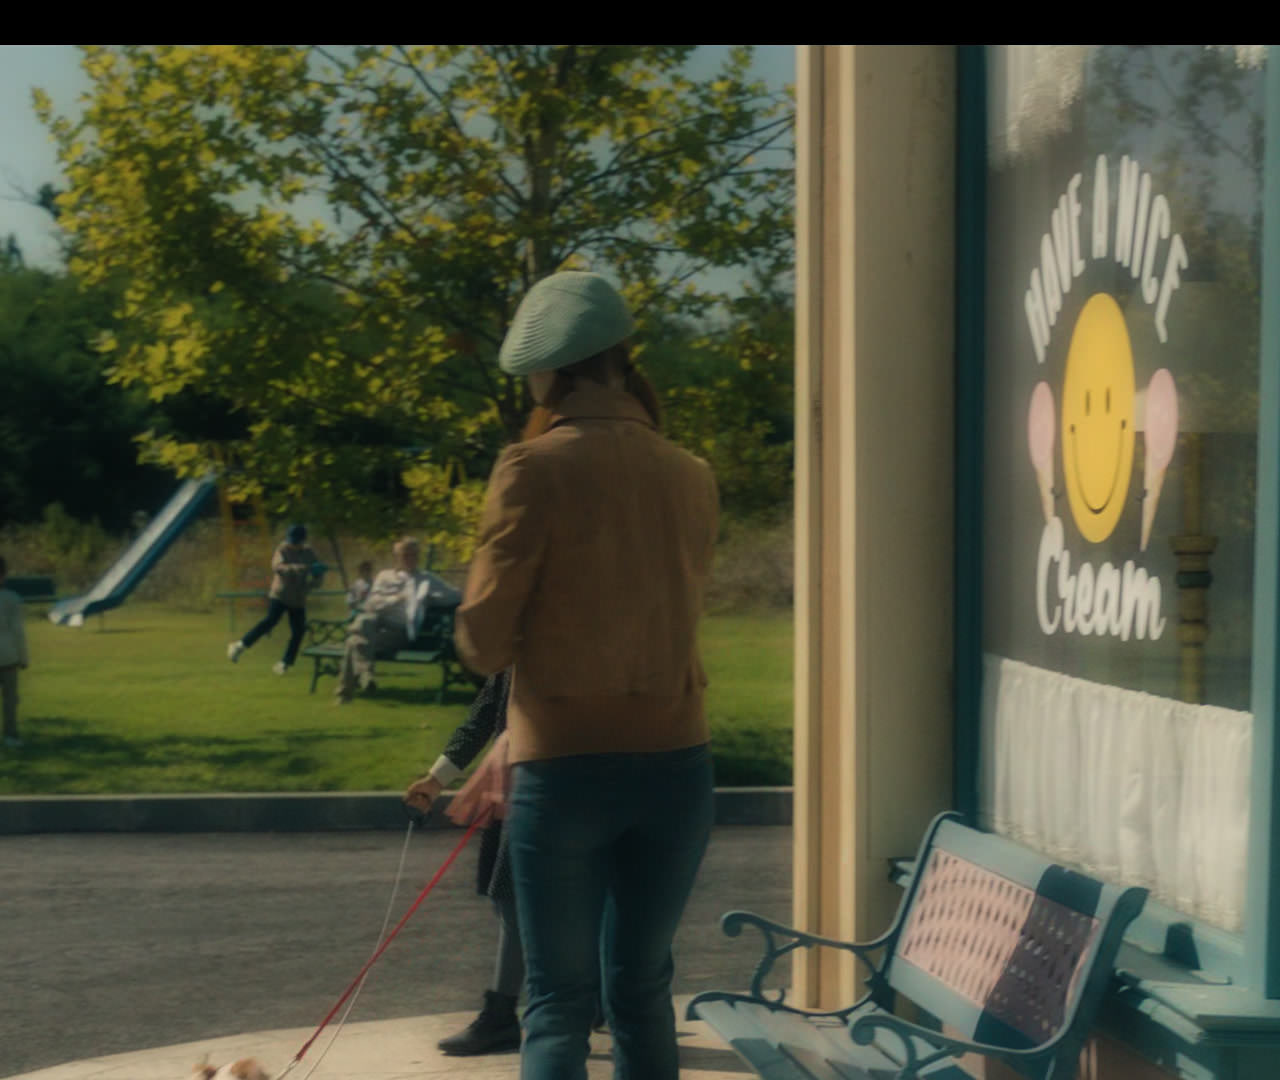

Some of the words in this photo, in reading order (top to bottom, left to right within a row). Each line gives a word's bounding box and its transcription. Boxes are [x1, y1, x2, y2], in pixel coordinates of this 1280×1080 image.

[1024, 172, 1086, 364] HAVE
[1091, 152, 1109, 260] A
[1115, 153, 1189, 343] NICE
[1035, 515, 1166, 642] Cream
